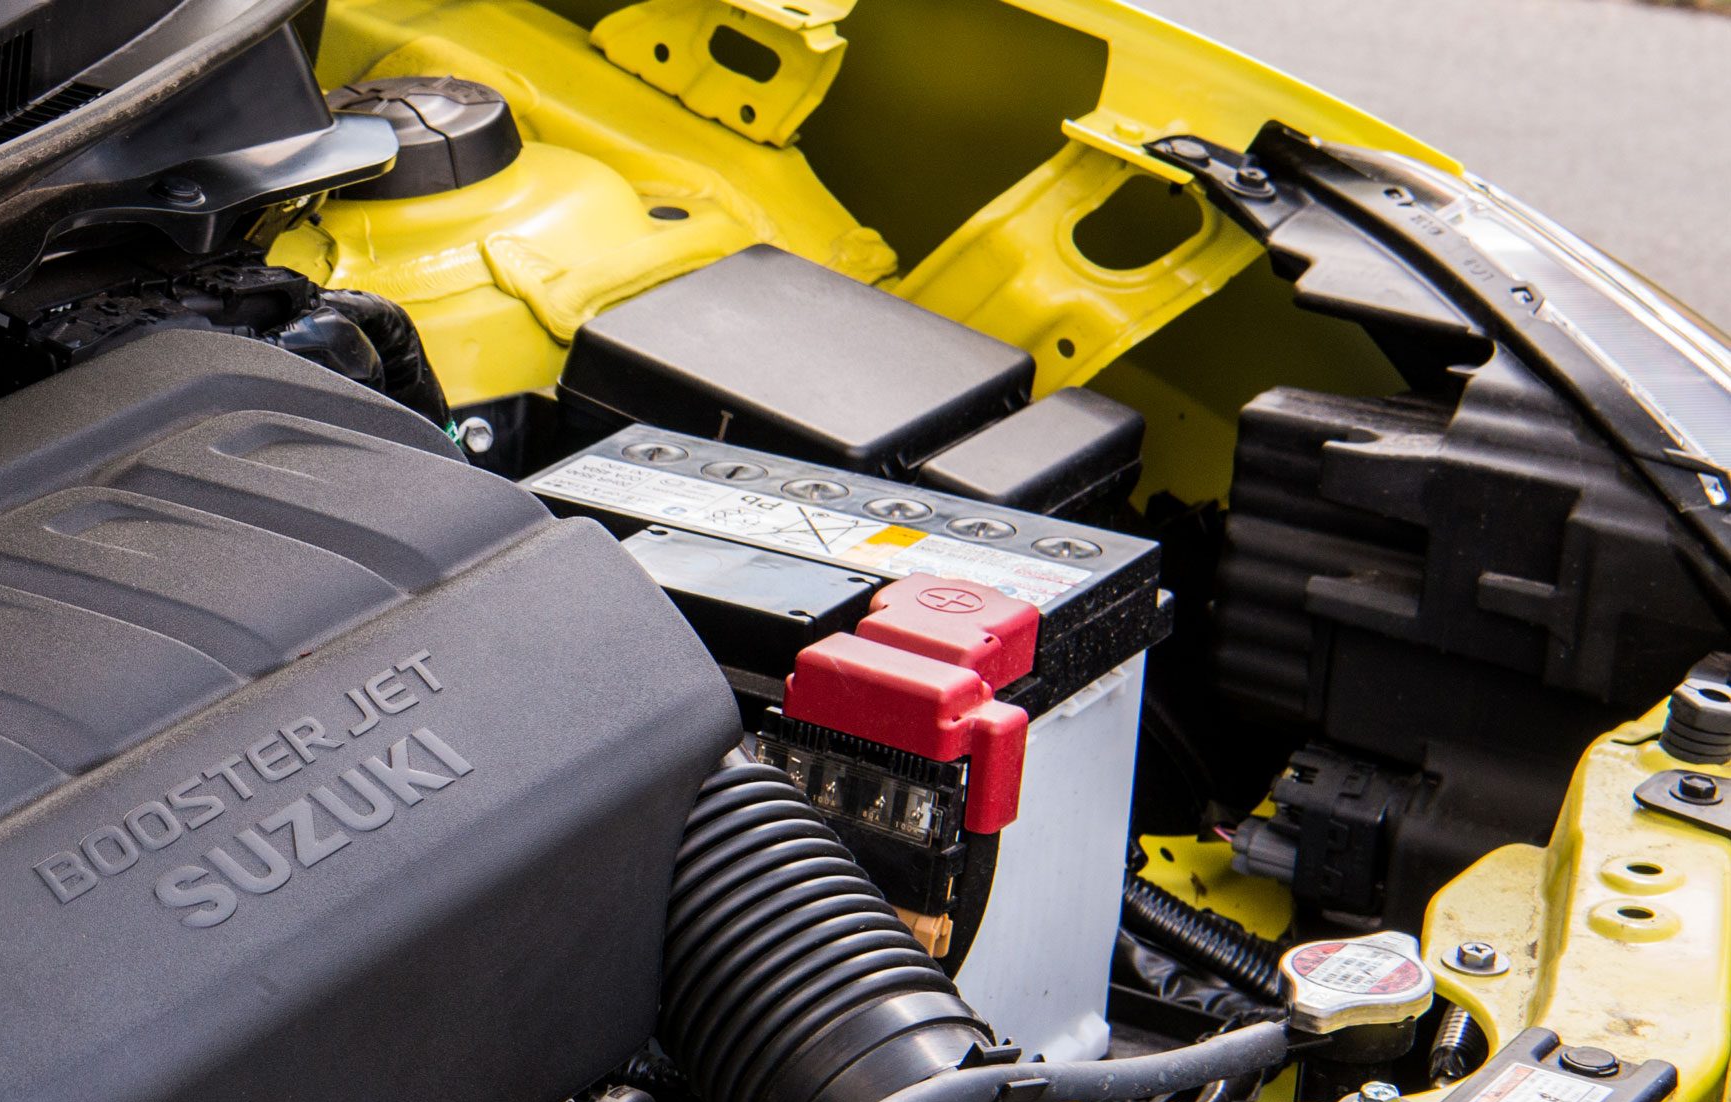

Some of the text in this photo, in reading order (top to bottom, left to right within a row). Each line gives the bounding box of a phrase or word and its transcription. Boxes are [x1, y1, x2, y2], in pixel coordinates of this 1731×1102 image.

[740, 491, 783, 514] Pb
[31, 648, 444, 904] BOOSTER JET
[153, 726, 474, 928] SUZUKI
